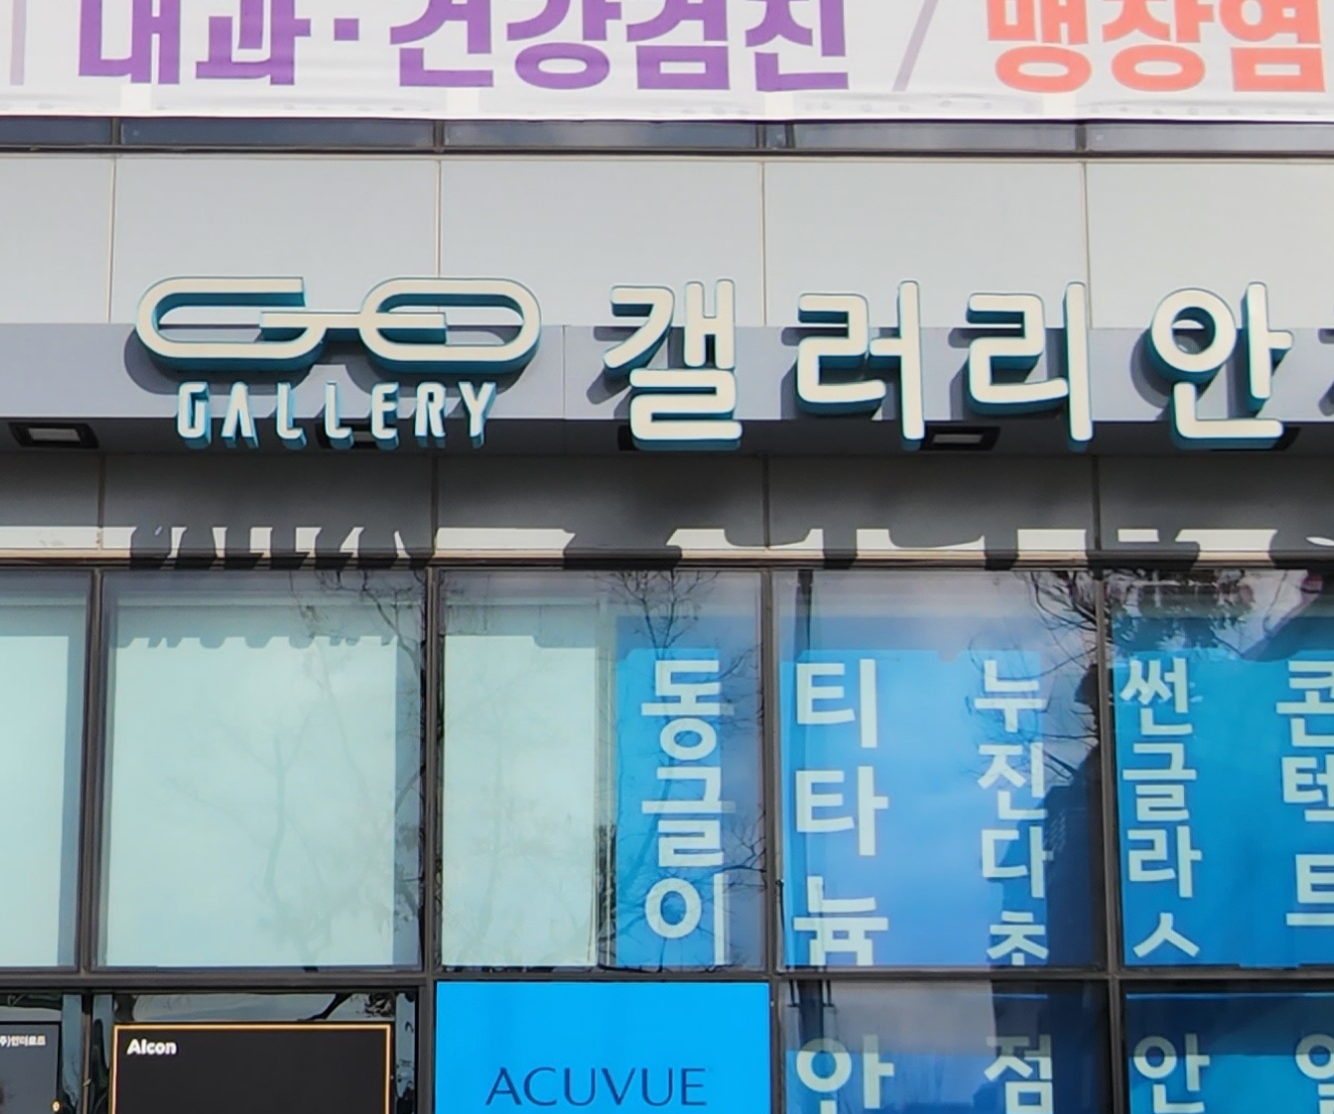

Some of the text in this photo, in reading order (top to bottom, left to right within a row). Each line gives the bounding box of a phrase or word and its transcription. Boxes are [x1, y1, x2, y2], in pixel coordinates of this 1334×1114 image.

[177, 381, 497, 449] GALLERY
[641, 660, 735, 965] 동글이
[793, 659, 889, 967] 티타늄
[127, 1039, 177, 1055] Alcon
[485, 1067, 708, 1107] ACUVUE
